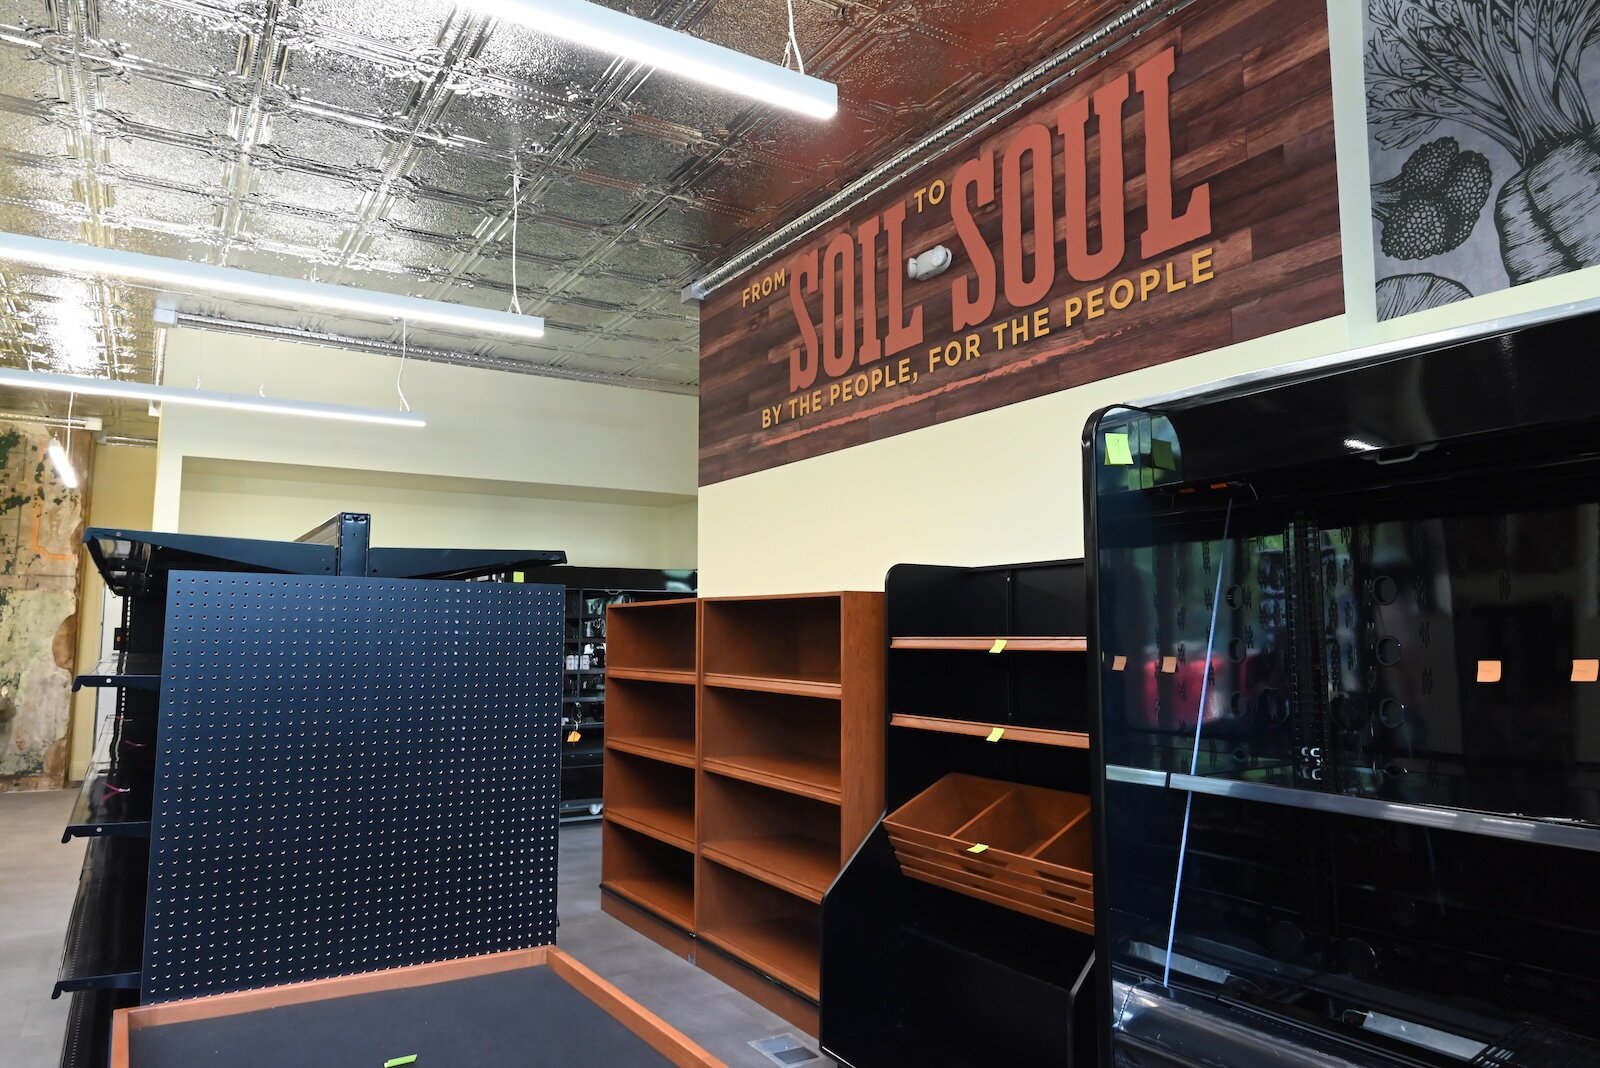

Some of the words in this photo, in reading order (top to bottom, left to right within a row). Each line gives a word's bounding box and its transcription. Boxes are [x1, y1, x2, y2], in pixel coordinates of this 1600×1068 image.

[742, 268, 786, 308] FROM
[789, 200, 924, 393] SOIL
[913, 179, 945, 213] TO
[951, 47, 1212, 331] SOUL
[761, 405, 782, 429] BY
[789, 391, 822, 418] THE
[830, 357, 918, 406] PEOPLE,
[929, 334, 980, 372] FOR
[993, 307, 1050, 350] THE
[1066, 249, 1214, 327] PEOPLE
